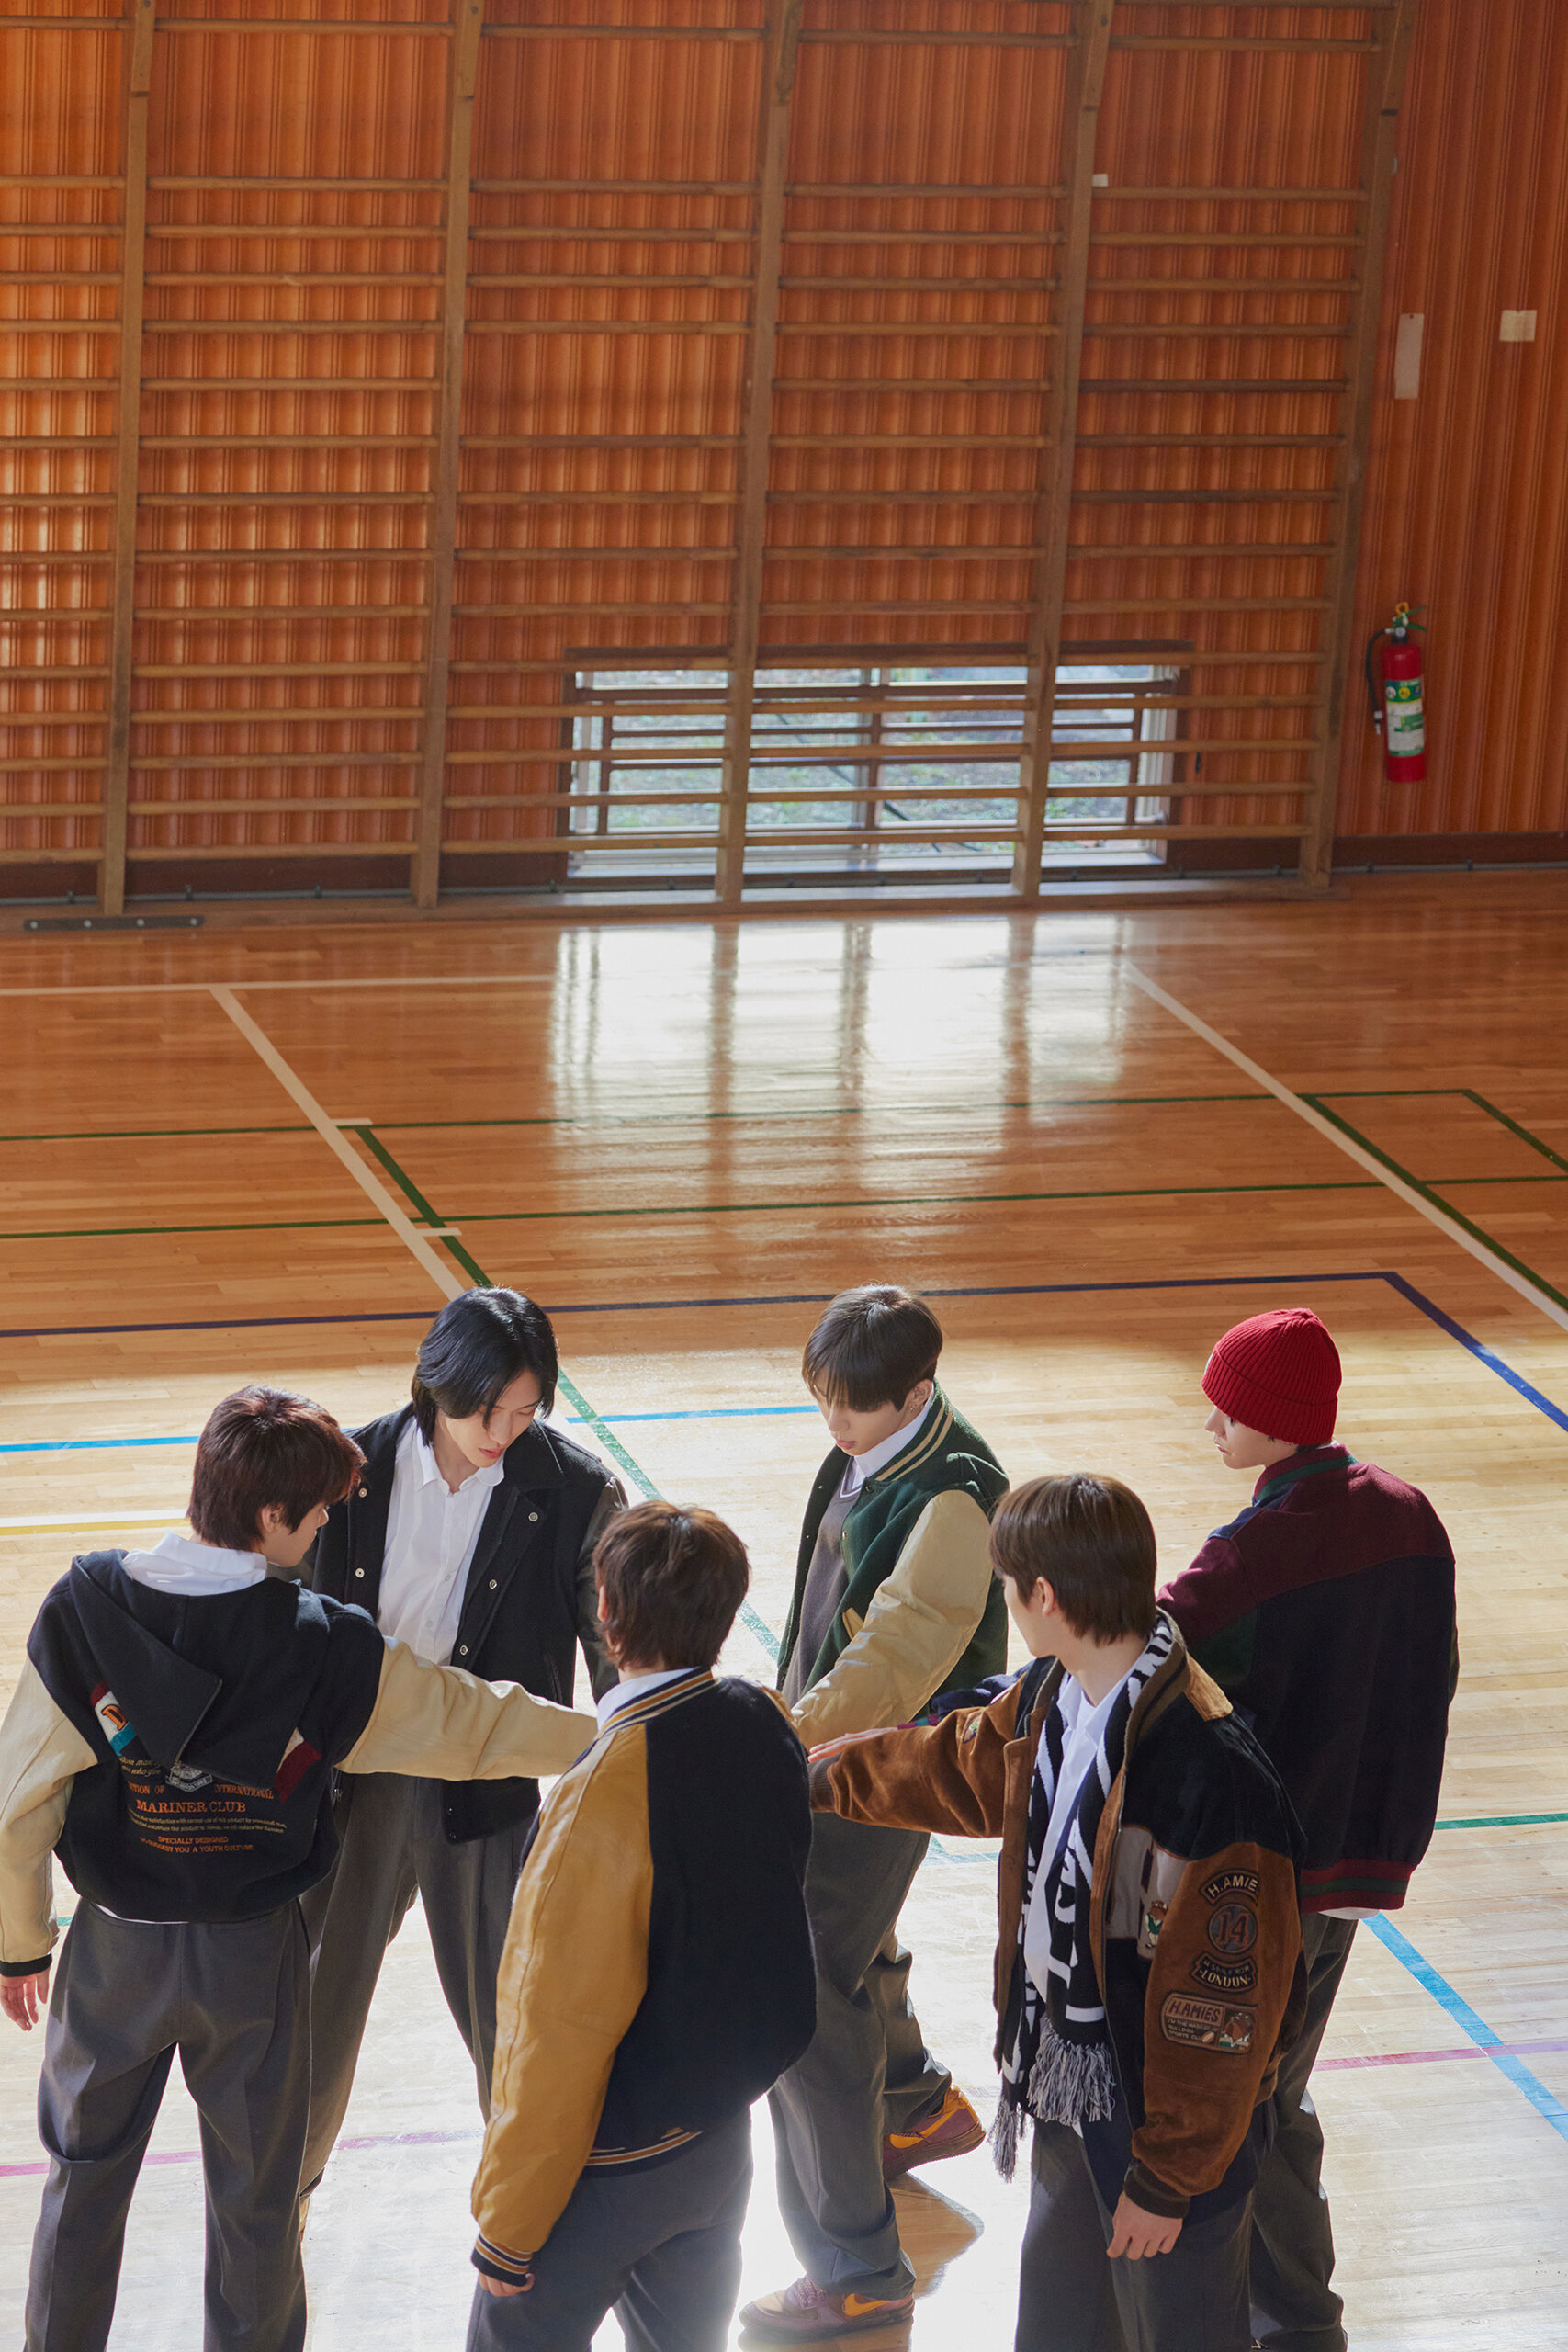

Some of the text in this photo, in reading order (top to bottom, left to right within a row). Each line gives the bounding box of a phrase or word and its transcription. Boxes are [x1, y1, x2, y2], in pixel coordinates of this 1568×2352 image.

[214, 1784, 275, 1800] INTERNATIONAL
[136, 1799, 246, 1814] MARINER CLUB
[157, 1836, 229, 1845] SPECIALLY DESIGNED
[175, 1845, 190, 1853] YOU
[1208, 1874, 1260, 1899] H.AMIE
[1215, 1911, 1250, 1946] 14
[1168, 2000, 1221, 2022] H.AMIES
